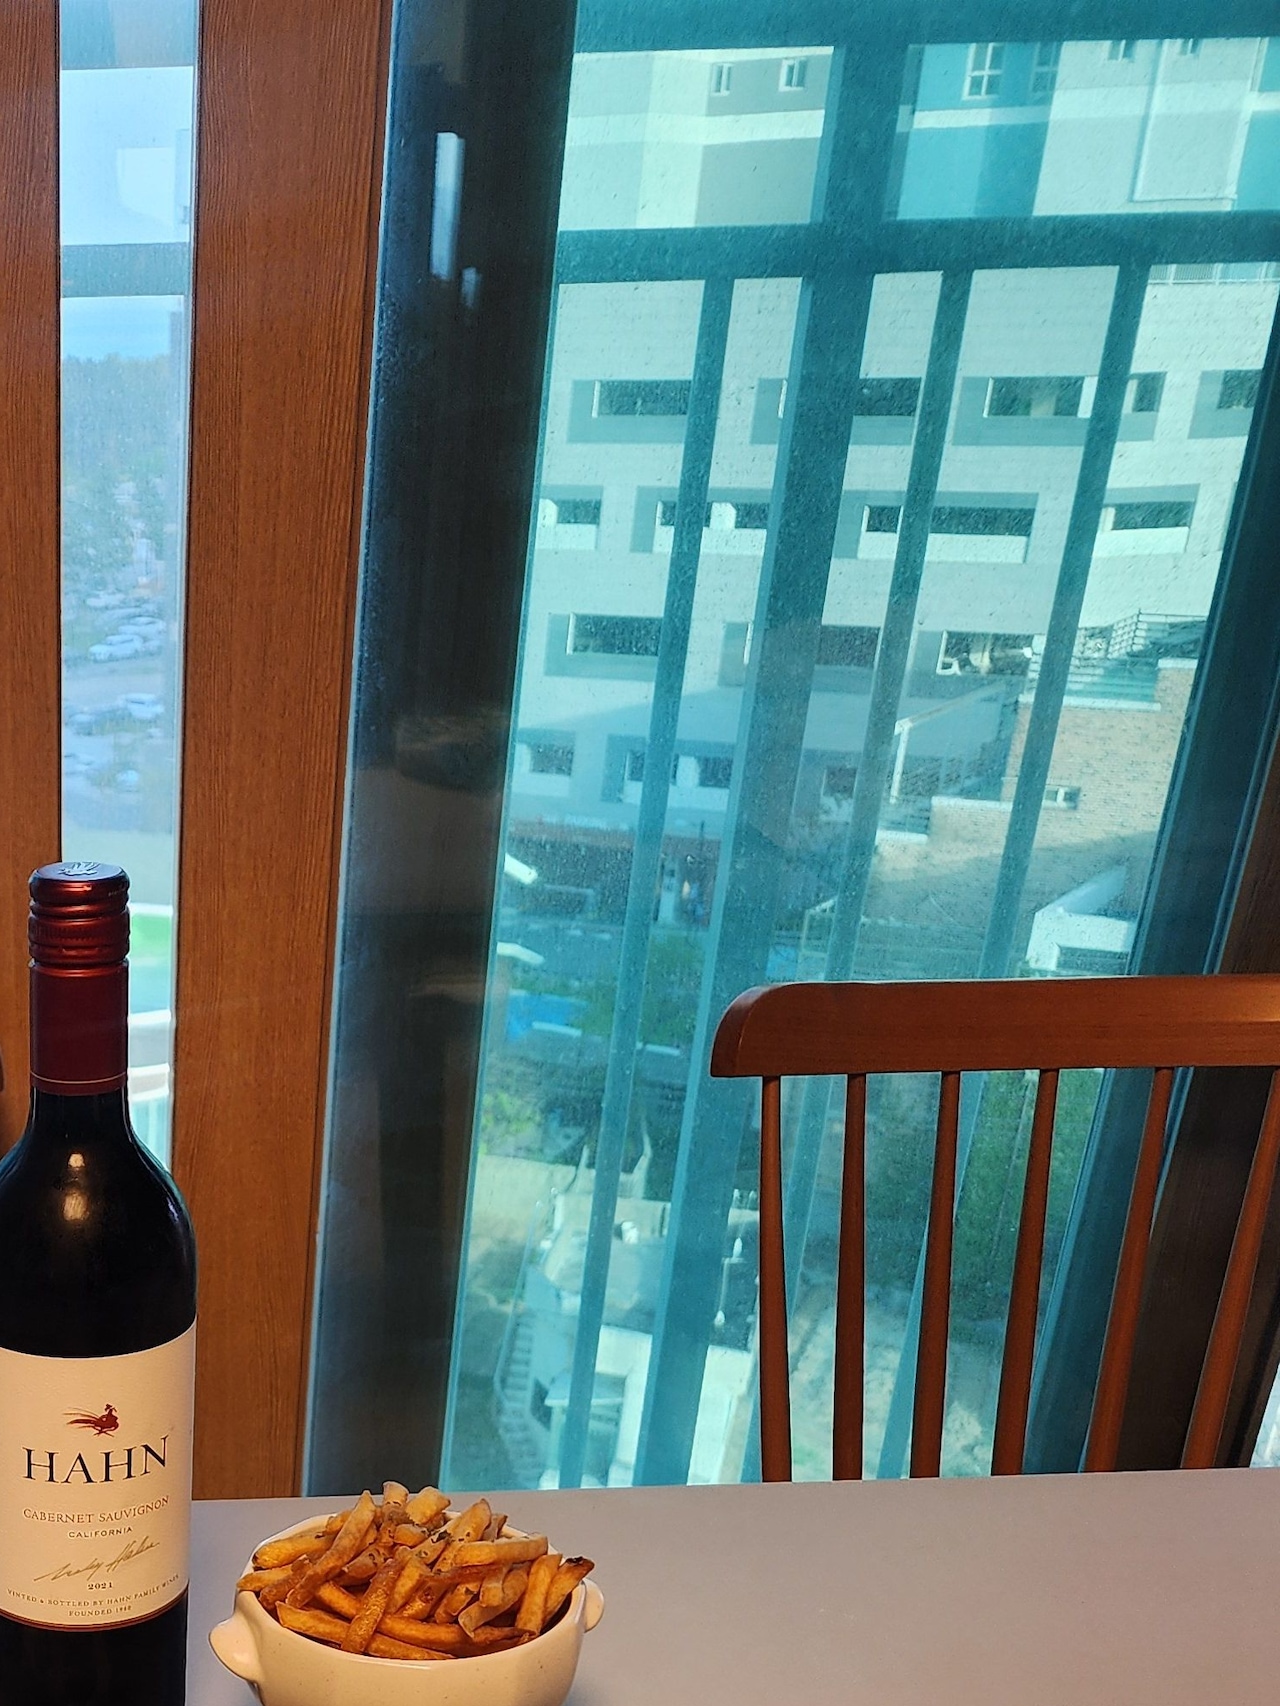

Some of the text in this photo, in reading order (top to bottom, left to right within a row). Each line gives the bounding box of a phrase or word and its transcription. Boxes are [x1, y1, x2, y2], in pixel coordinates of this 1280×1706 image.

[22, 1434, 169, 1484] HAHN
[23, 1495, 169, 1524] CABERNET SAUVIGNON
[68, 1526, 133, 1538] CALIFORNIA
[88, 1582, 113, 1590] 2021
[7, 1588, 37, 1602] VINTED
[107, 1595, 131, 1605] HAHN
[134, 1586, 160, 1599] FAMILY
[69, 1608, 112, 1617] FOUNDED
